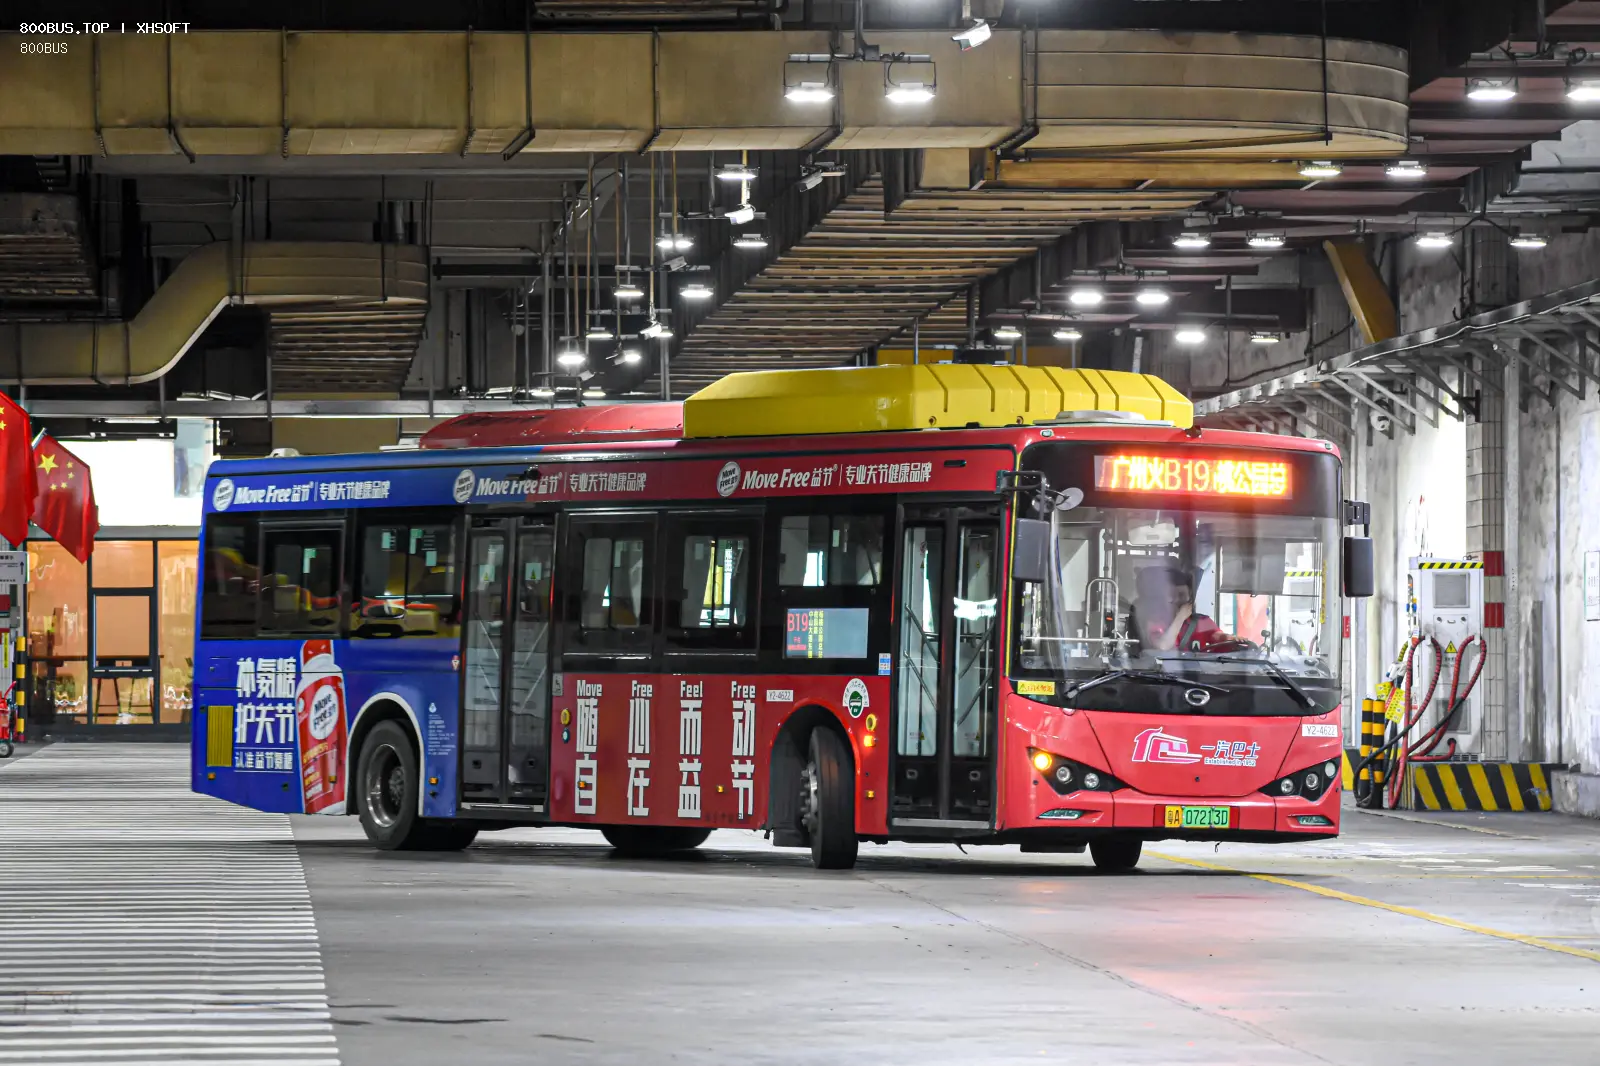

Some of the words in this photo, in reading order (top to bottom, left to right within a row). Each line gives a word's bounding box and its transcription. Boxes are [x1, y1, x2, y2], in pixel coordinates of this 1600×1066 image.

[476, 478, 508, 497] Move
[569, 472, 647, 492] 专业关节健康品牌
[742, 470, 778, 490] Move
[779, 468, 811, 488] Free
[845, 461, 933, 485] 专业关节健康品牌
[1164, 458, 1209, 491] B19
[233, 486, 266, 505] Move
[265, 485, 292, 503] Free
[787, 612, 809, 632] B19
[576, 680, 603, 697] Move
[631, 680, 653, 698] Free
[680, 680, 703, 698] Feel
[731, 681, 756, 699] Free
[235, 702, 296, 744] 护关节
[1306, 725, 1336, 736] Y2-4622
[1200, 740, 1261, 759] 一汽巴士
